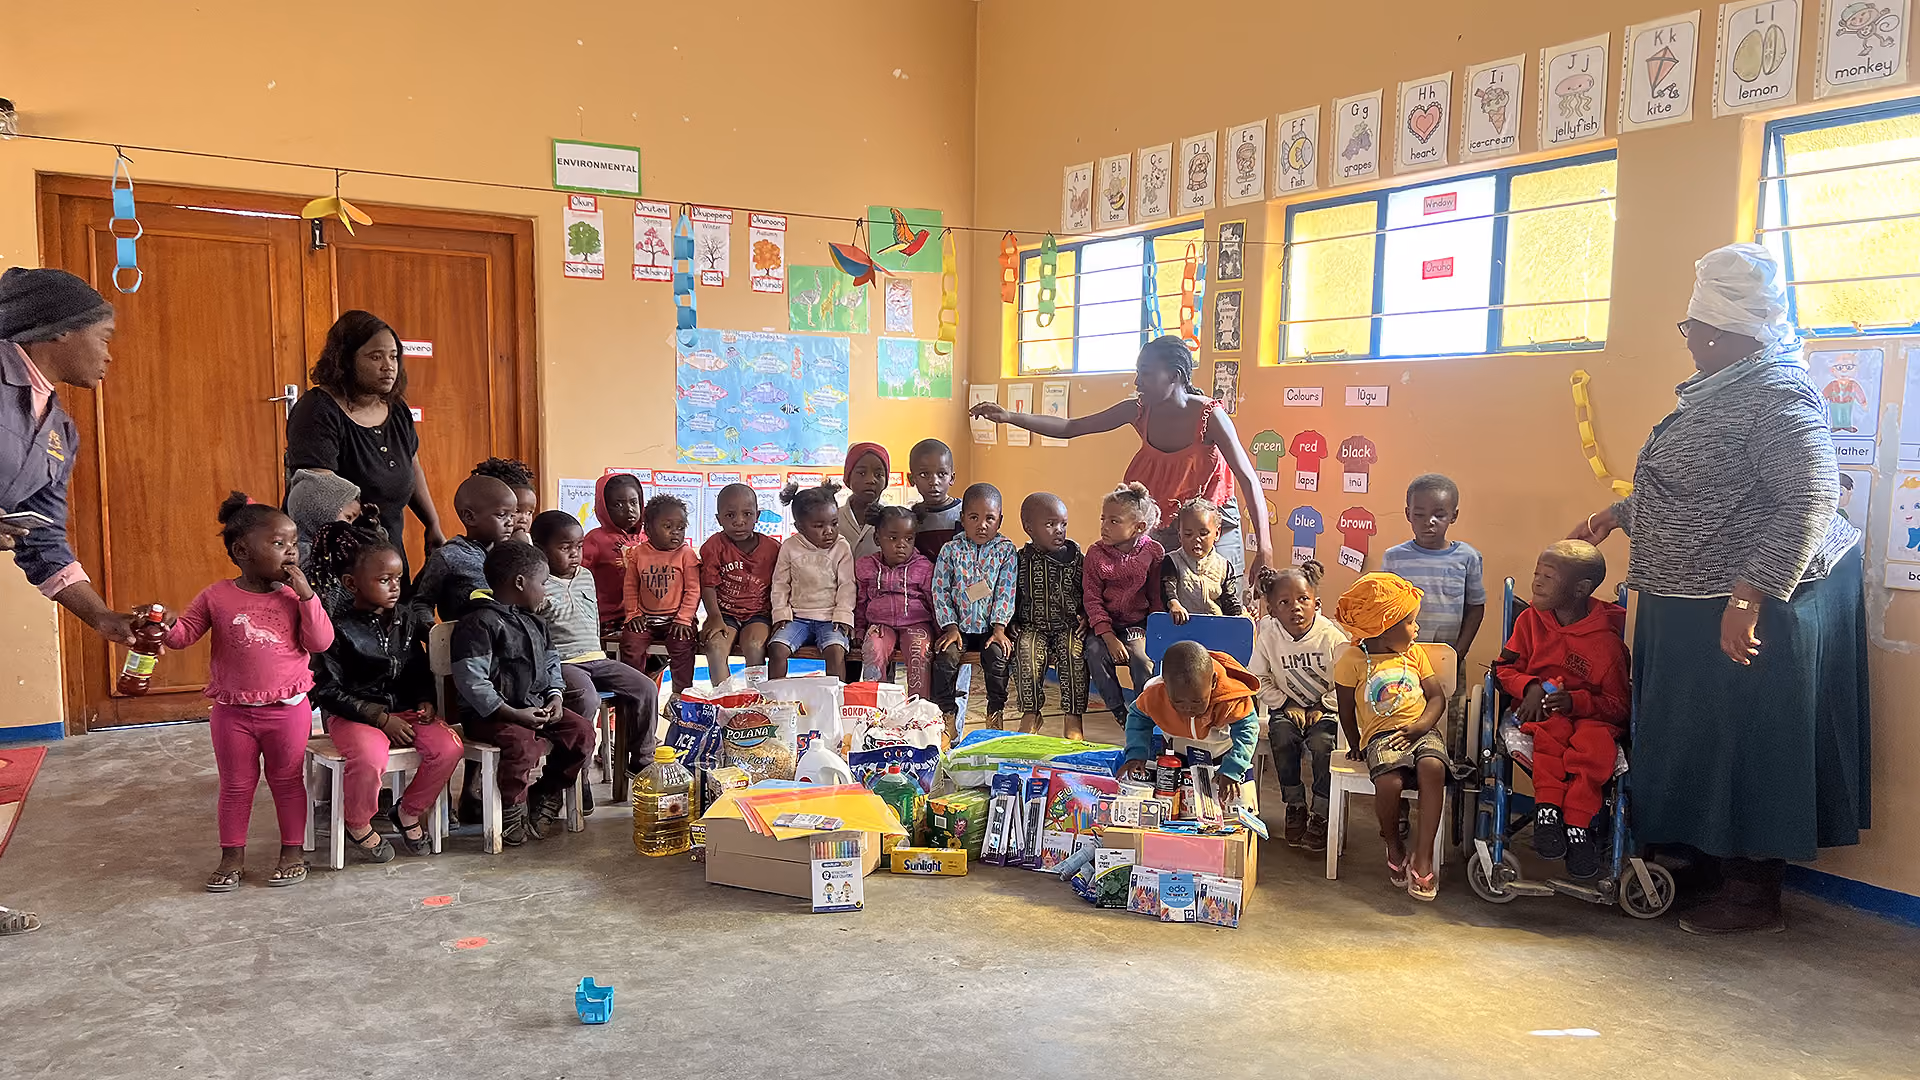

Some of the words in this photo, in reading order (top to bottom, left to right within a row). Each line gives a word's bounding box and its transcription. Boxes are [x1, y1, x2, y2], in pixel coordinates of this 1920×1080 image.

[1653, 31, 1664, 47] K
[1567, 54, 1578, 70] J
[1834, 58, 1893, 80] monkey
[1737, 84, 1779, 100] lemon
[1646, 102, 1672, 116] kite
[1549, 116, 1599, 143] jellyfish
[1469, 135, 1515, 149] ice-cream
[1410, 147, 1437, 160] heart
[557, 157, 638, 174] ENVIRONMENTAL
[1343, 161, 1373, 178] grapes
[1290, 176, 1306, 189] fish
[1240, 184, 1252, 196] elf
[1192, 193, 1204, 206] dog
[1425, 198, 1454, 208] Window
[1109, 211, 1120, 220] bee
[643, 218, 663, 227] Spring
[1286, 389, 1319, 401] Colours
[1253, 441, 1282, 454] green
[1299, 440, 1318, 452] red
[1341, 444, 1371, 458] black
[567, 488, 595, 500] lightnin
[1294, 514, 1316, 527] blue
[1340, 515, 1373, 530] brown
[908, 628, 928, 689] PRINCESS
[1280, 652, 1324, 670] LIMIT
[726, 727, 769, 739] POLANA
[1086, 783, 1103, 798] TIM
[904, 859, 942, 872] Sunlight
[1168, 885, 1186, 893] edo
[1184, 910, 1194, 919] 12
